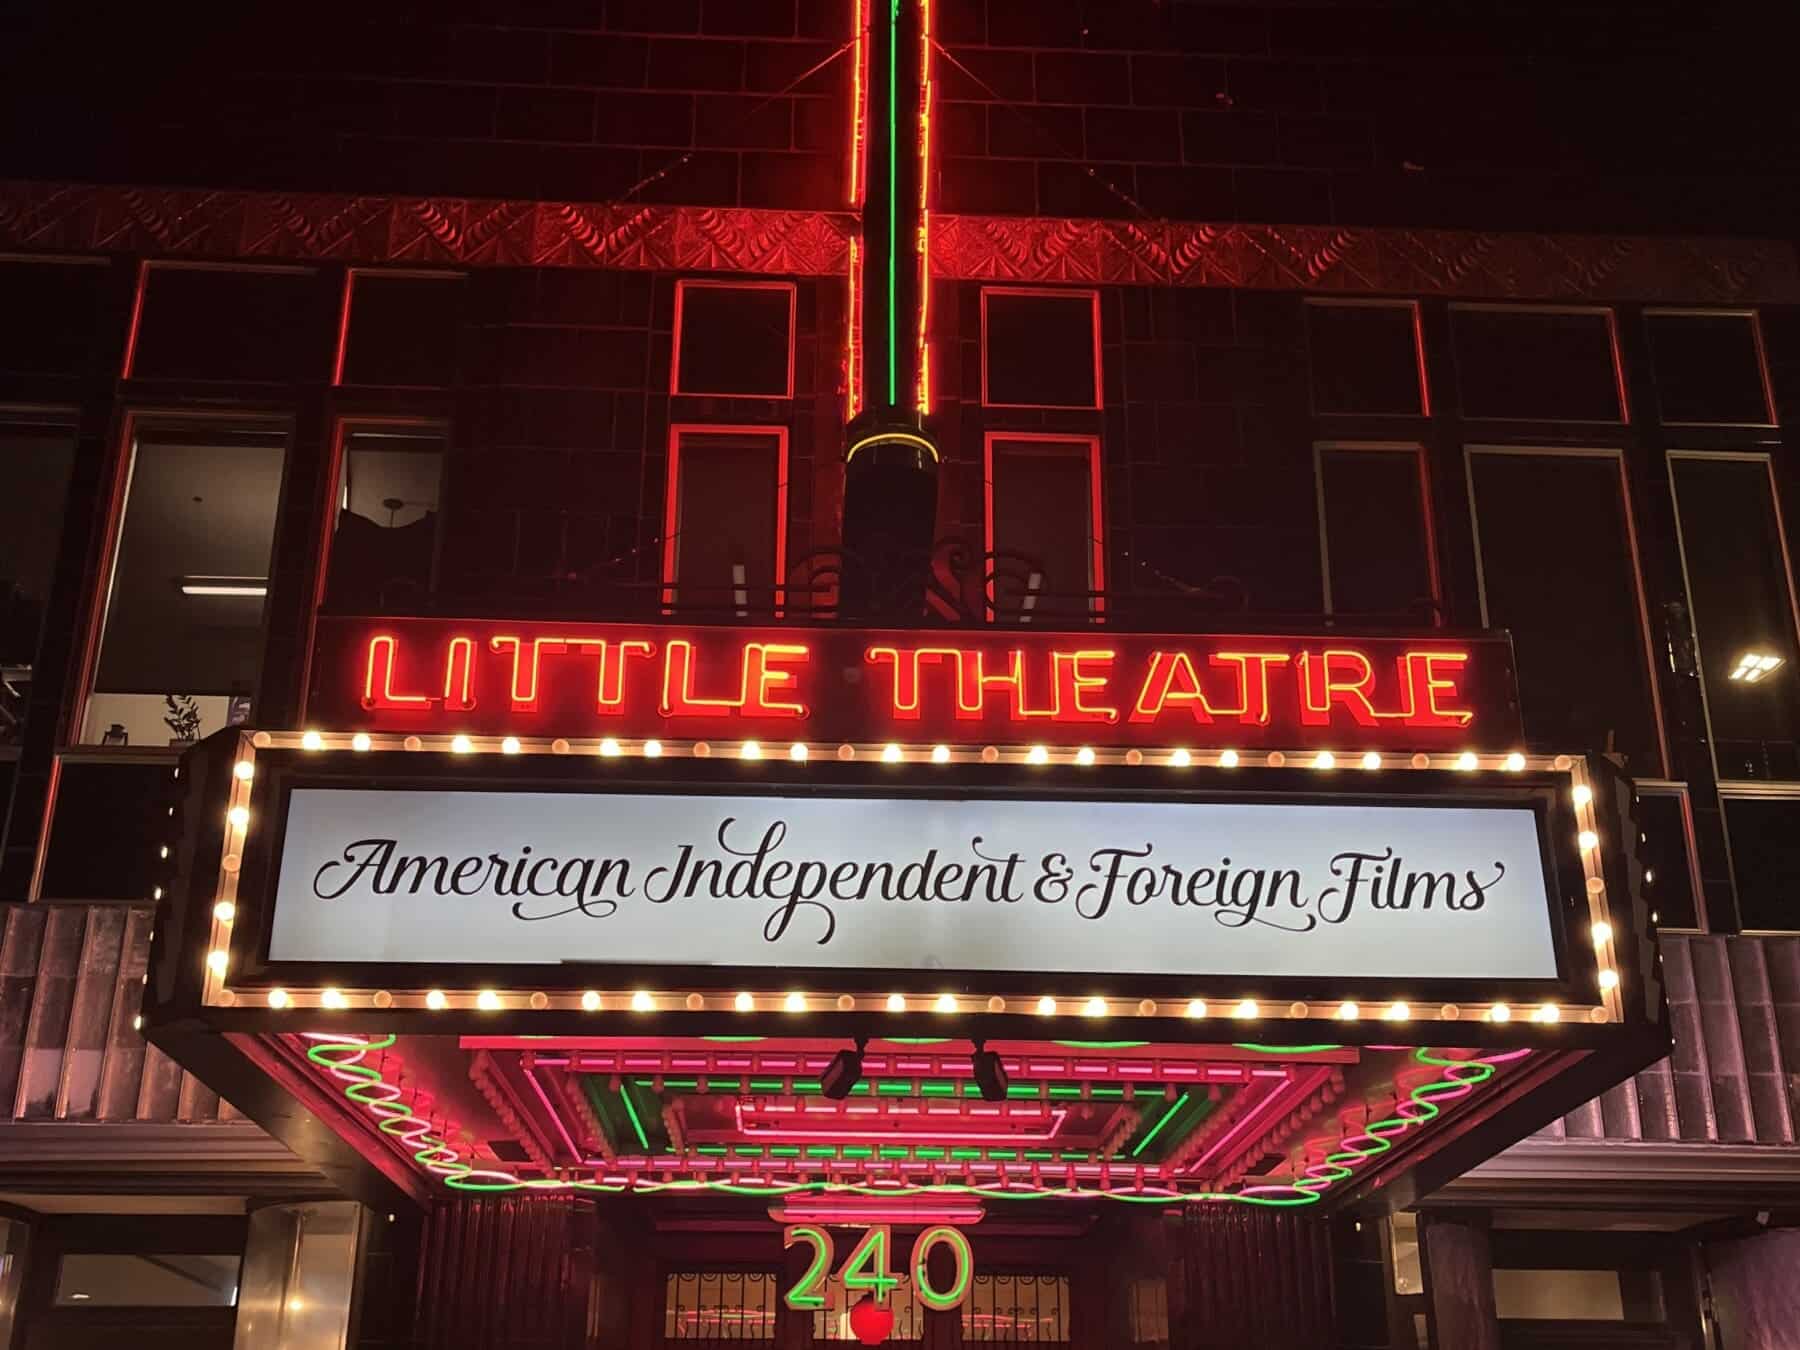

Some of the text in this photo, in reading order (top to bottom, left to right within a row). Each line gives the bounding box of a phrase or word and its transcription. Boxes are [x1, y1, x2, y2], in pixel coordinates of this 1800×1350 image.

[361, 634, 1474, 727] LITTLE THEATRE
[313, 817, 1505, 945] American Independent & Foreign Films
[784, 1224, 973, 1311] 240
